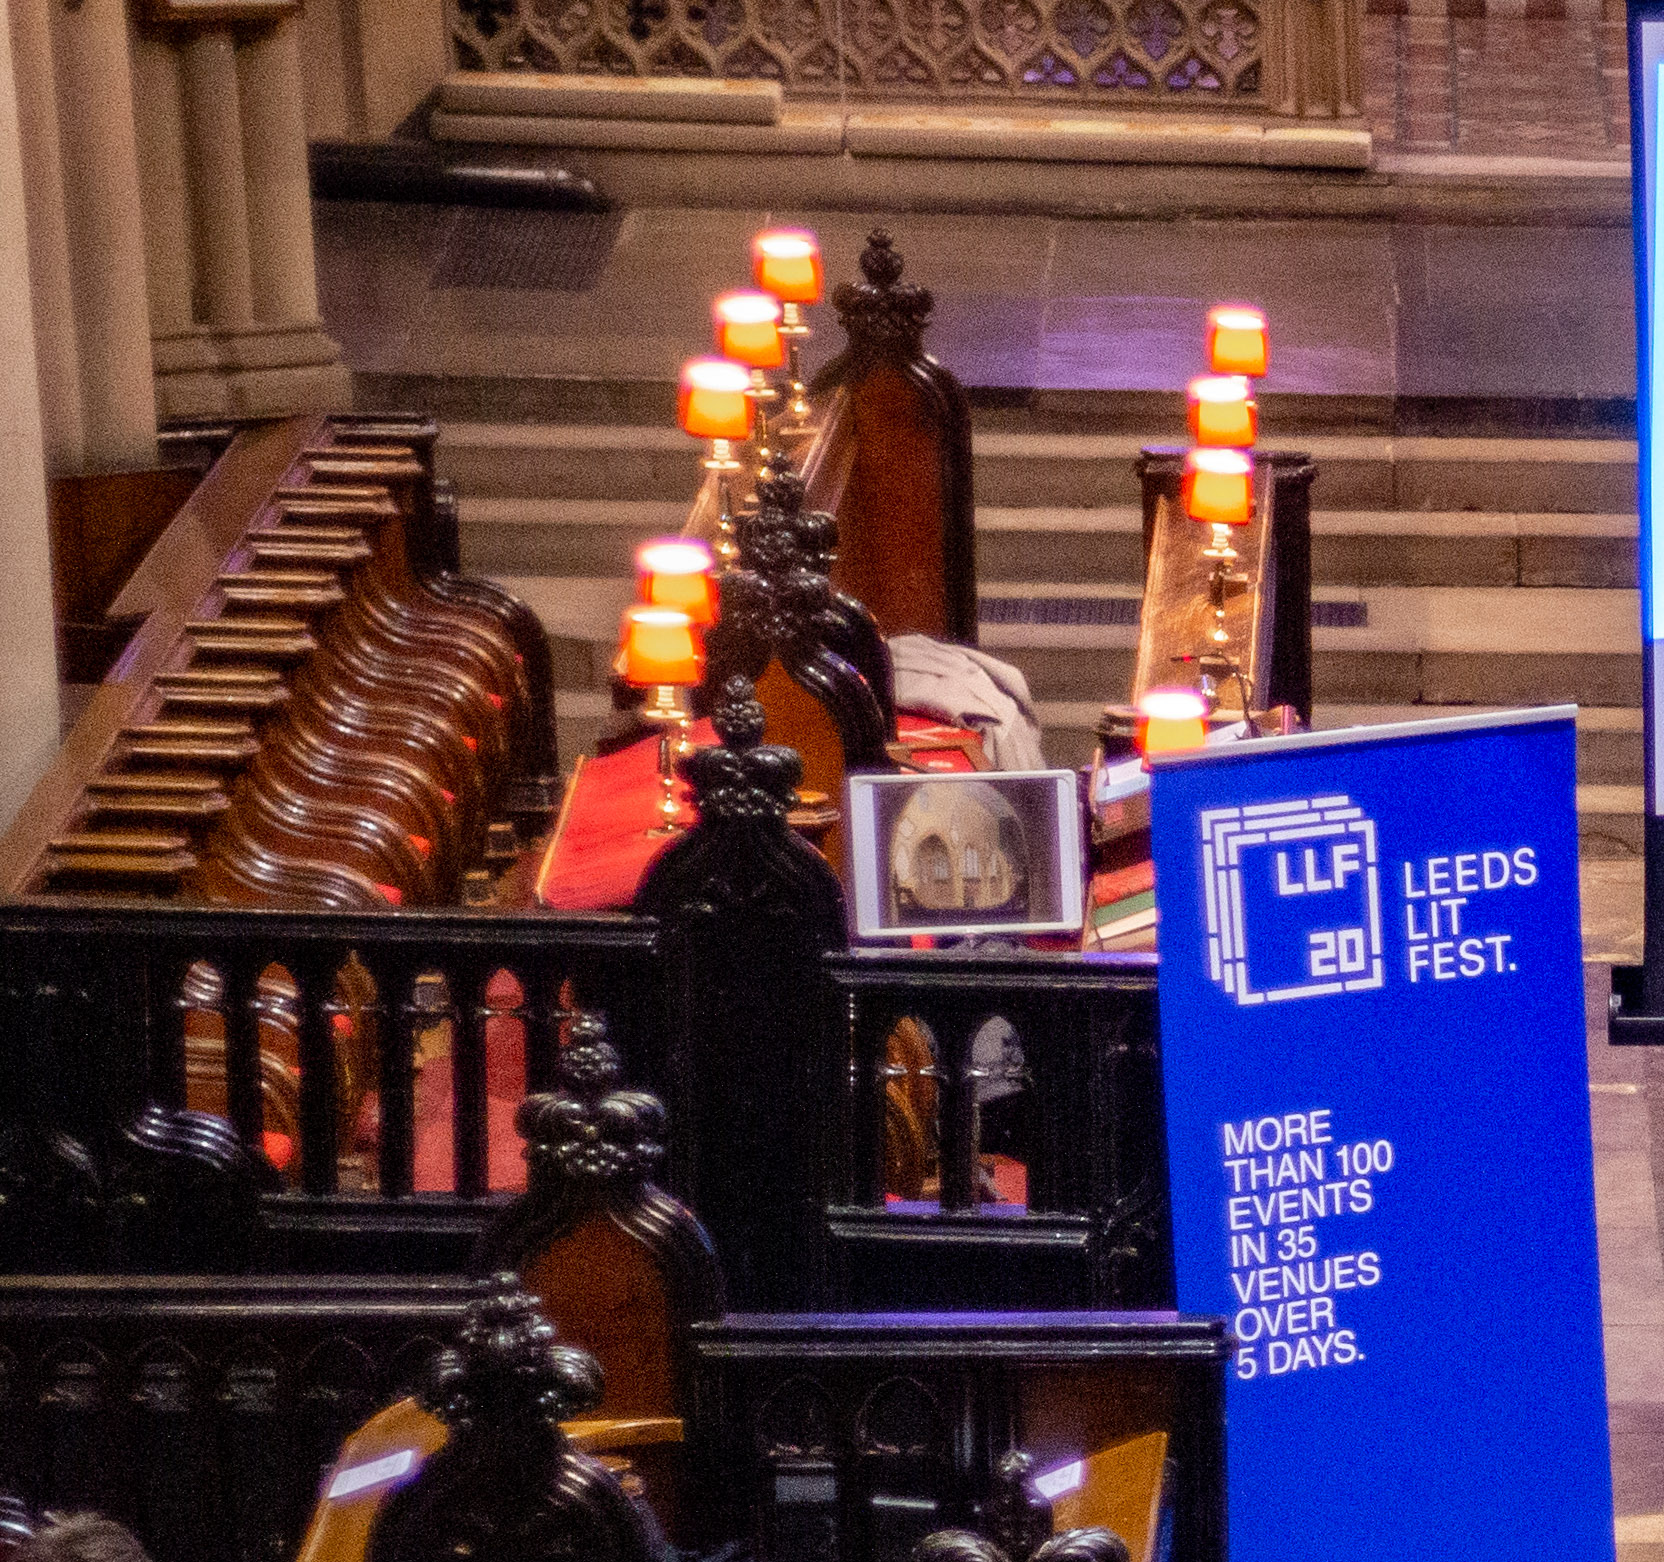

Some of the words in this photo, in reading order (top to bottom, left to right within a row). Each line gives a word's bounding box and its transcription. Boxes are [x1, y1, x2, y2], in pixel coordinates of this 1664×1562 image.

[1276, 843, 1361, 897] LLF
[1404, 846, 1538, 899] LEEDS
[1406, 897, 1467, 942] LIT
[1308, 927, 1367, 978] 20
[1408, 934, 1517, 983] FEST.
[1222, 1109, 1333, 1157] MORE
[1223, 1147, 1325, 1193] THAN
[1336, 1139, 1394, 1177] 100
[1228, 1177, 1373, 1232] EVENTS
[1230, 1231, 1268, 1268] IN
[1276, 1224, 1318, 1262] 35
[1230, 1251, 1381, 1305] VENUES
[1233, 1295, 1335, 1343] OVER
[1236, 1346, 1258, 1380] 5
[1267, 1329, 1365, 1375] DAYS.
